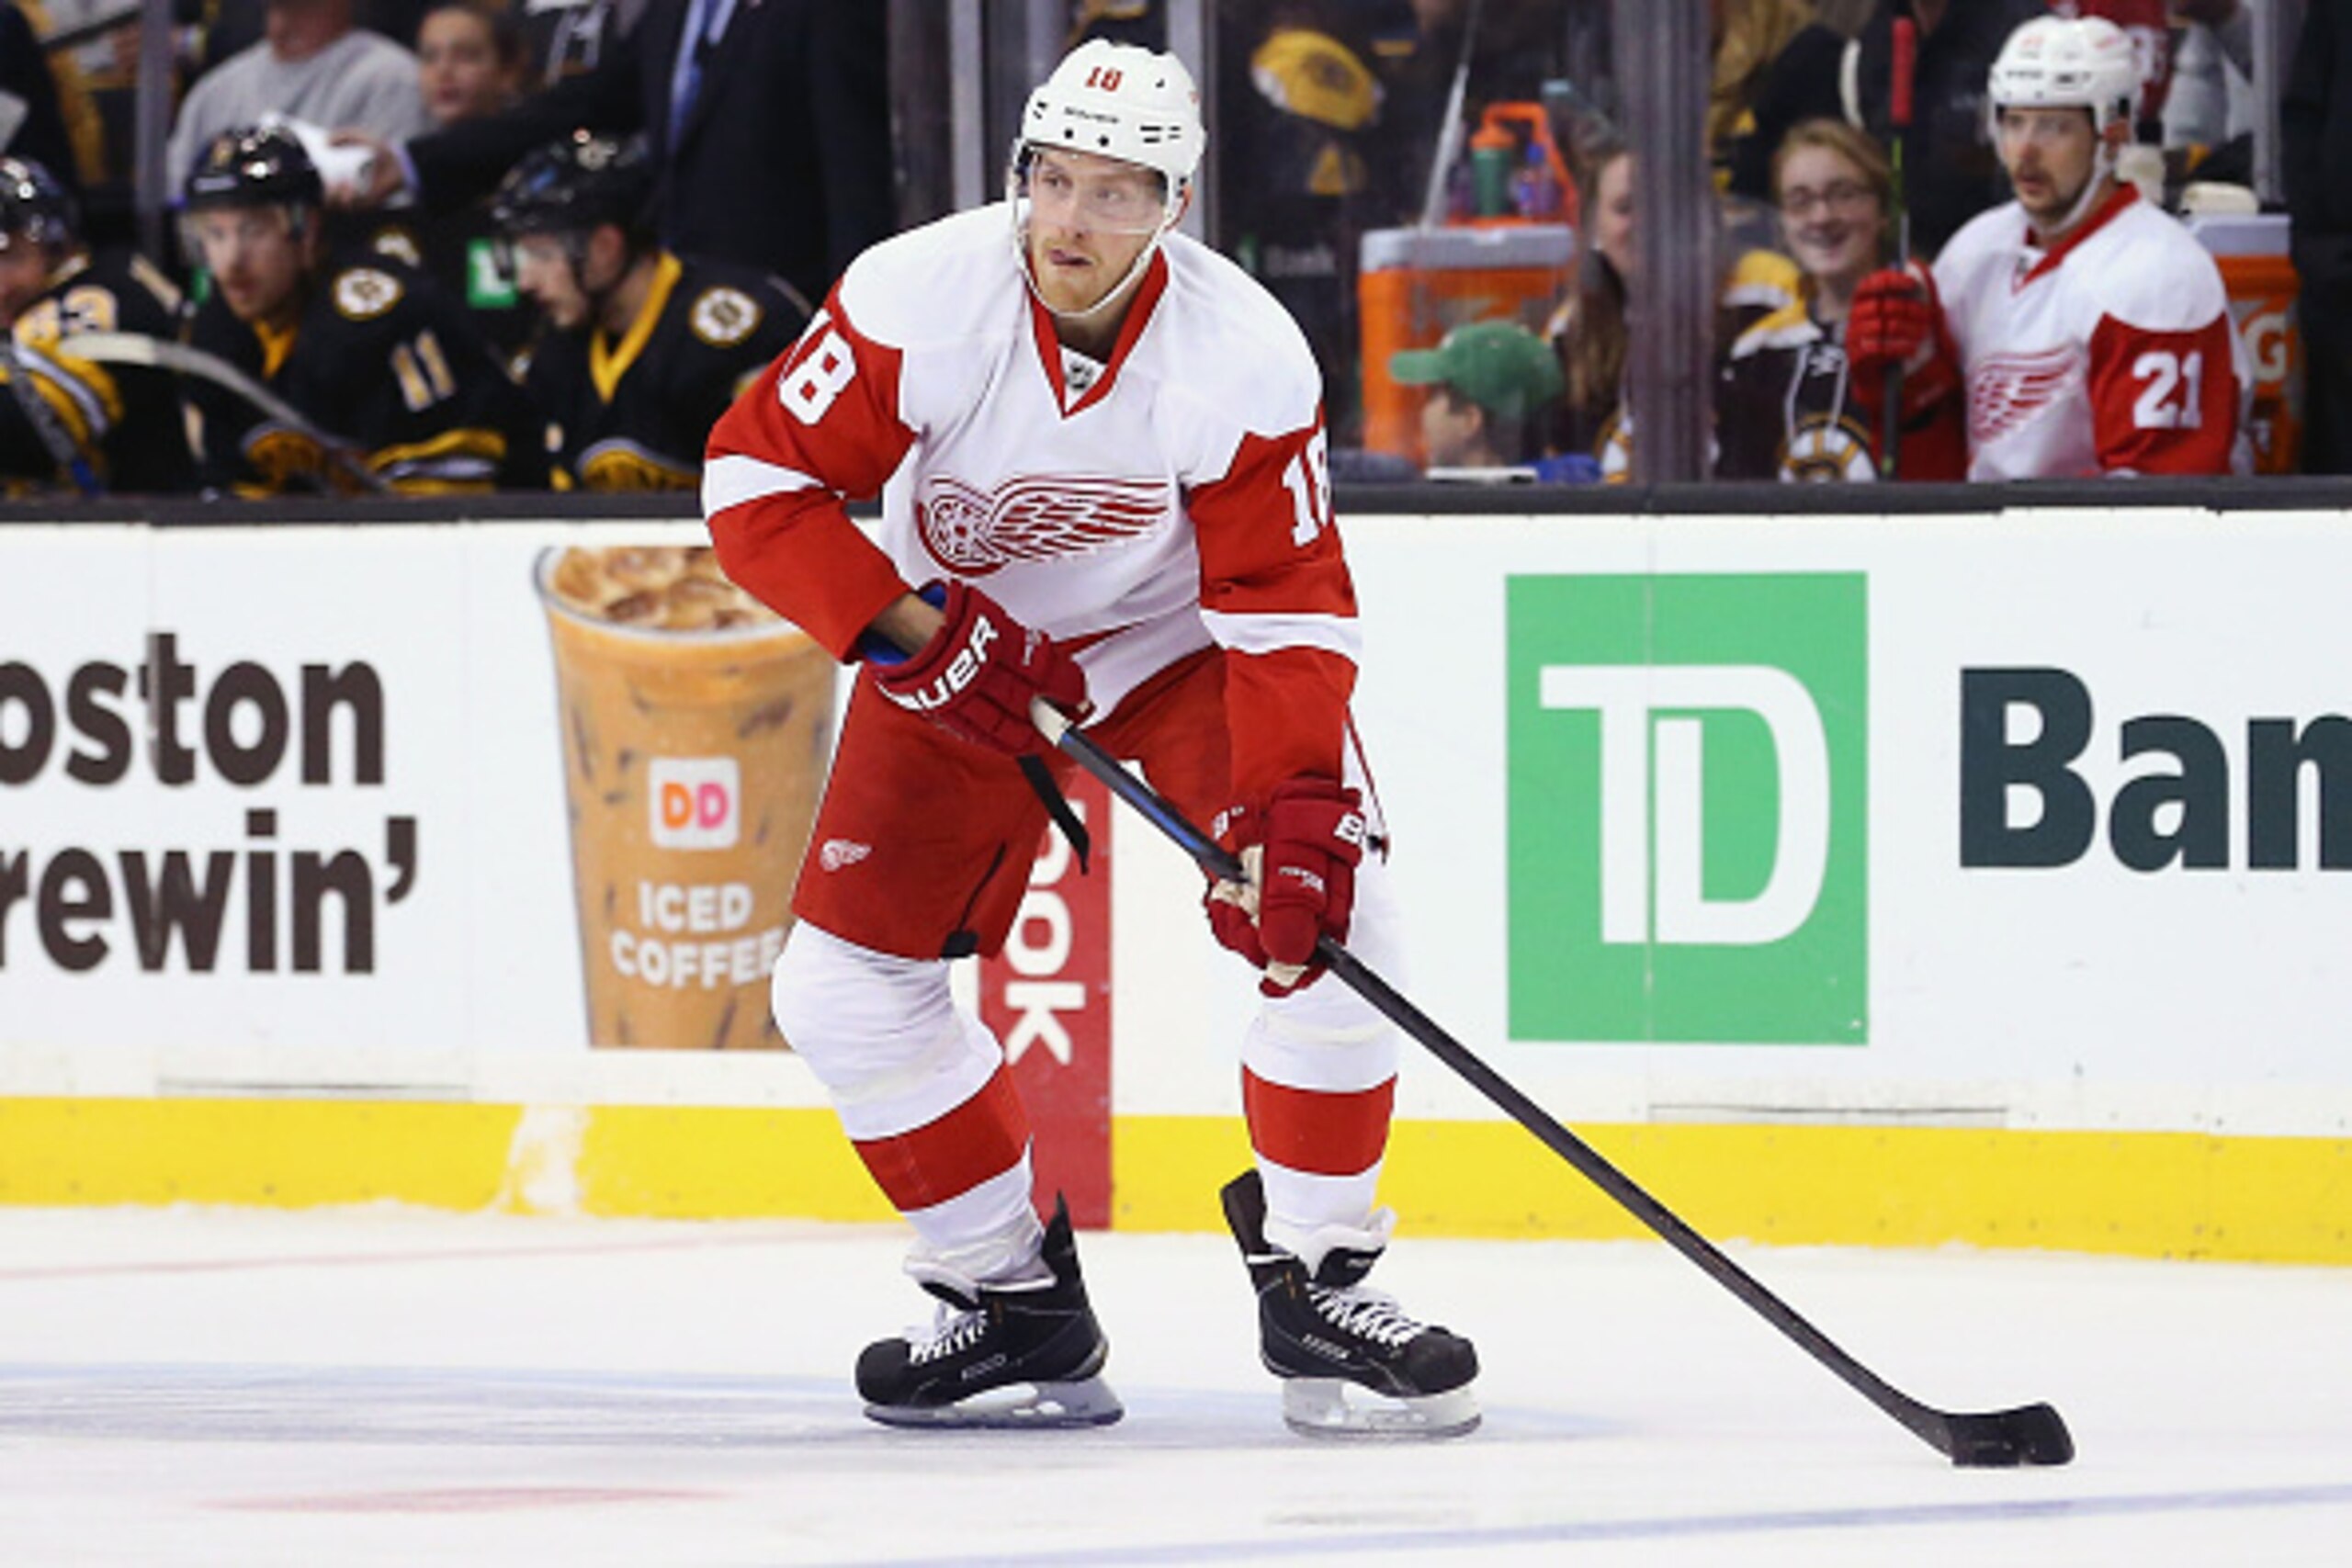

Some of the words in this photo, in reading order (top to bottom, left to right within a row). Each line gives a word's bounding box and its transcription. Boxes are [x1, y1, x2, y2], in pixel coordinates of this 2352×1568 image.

[1086, 66, 1124, 93] 18
[391, 334, 456, 412] 11
[2132, 349, 2202, 430] 21
[662, 781, 729, 830] DD
[1540, 664, 1831, 946] TD
[639, 880, 753, 931] ICED
